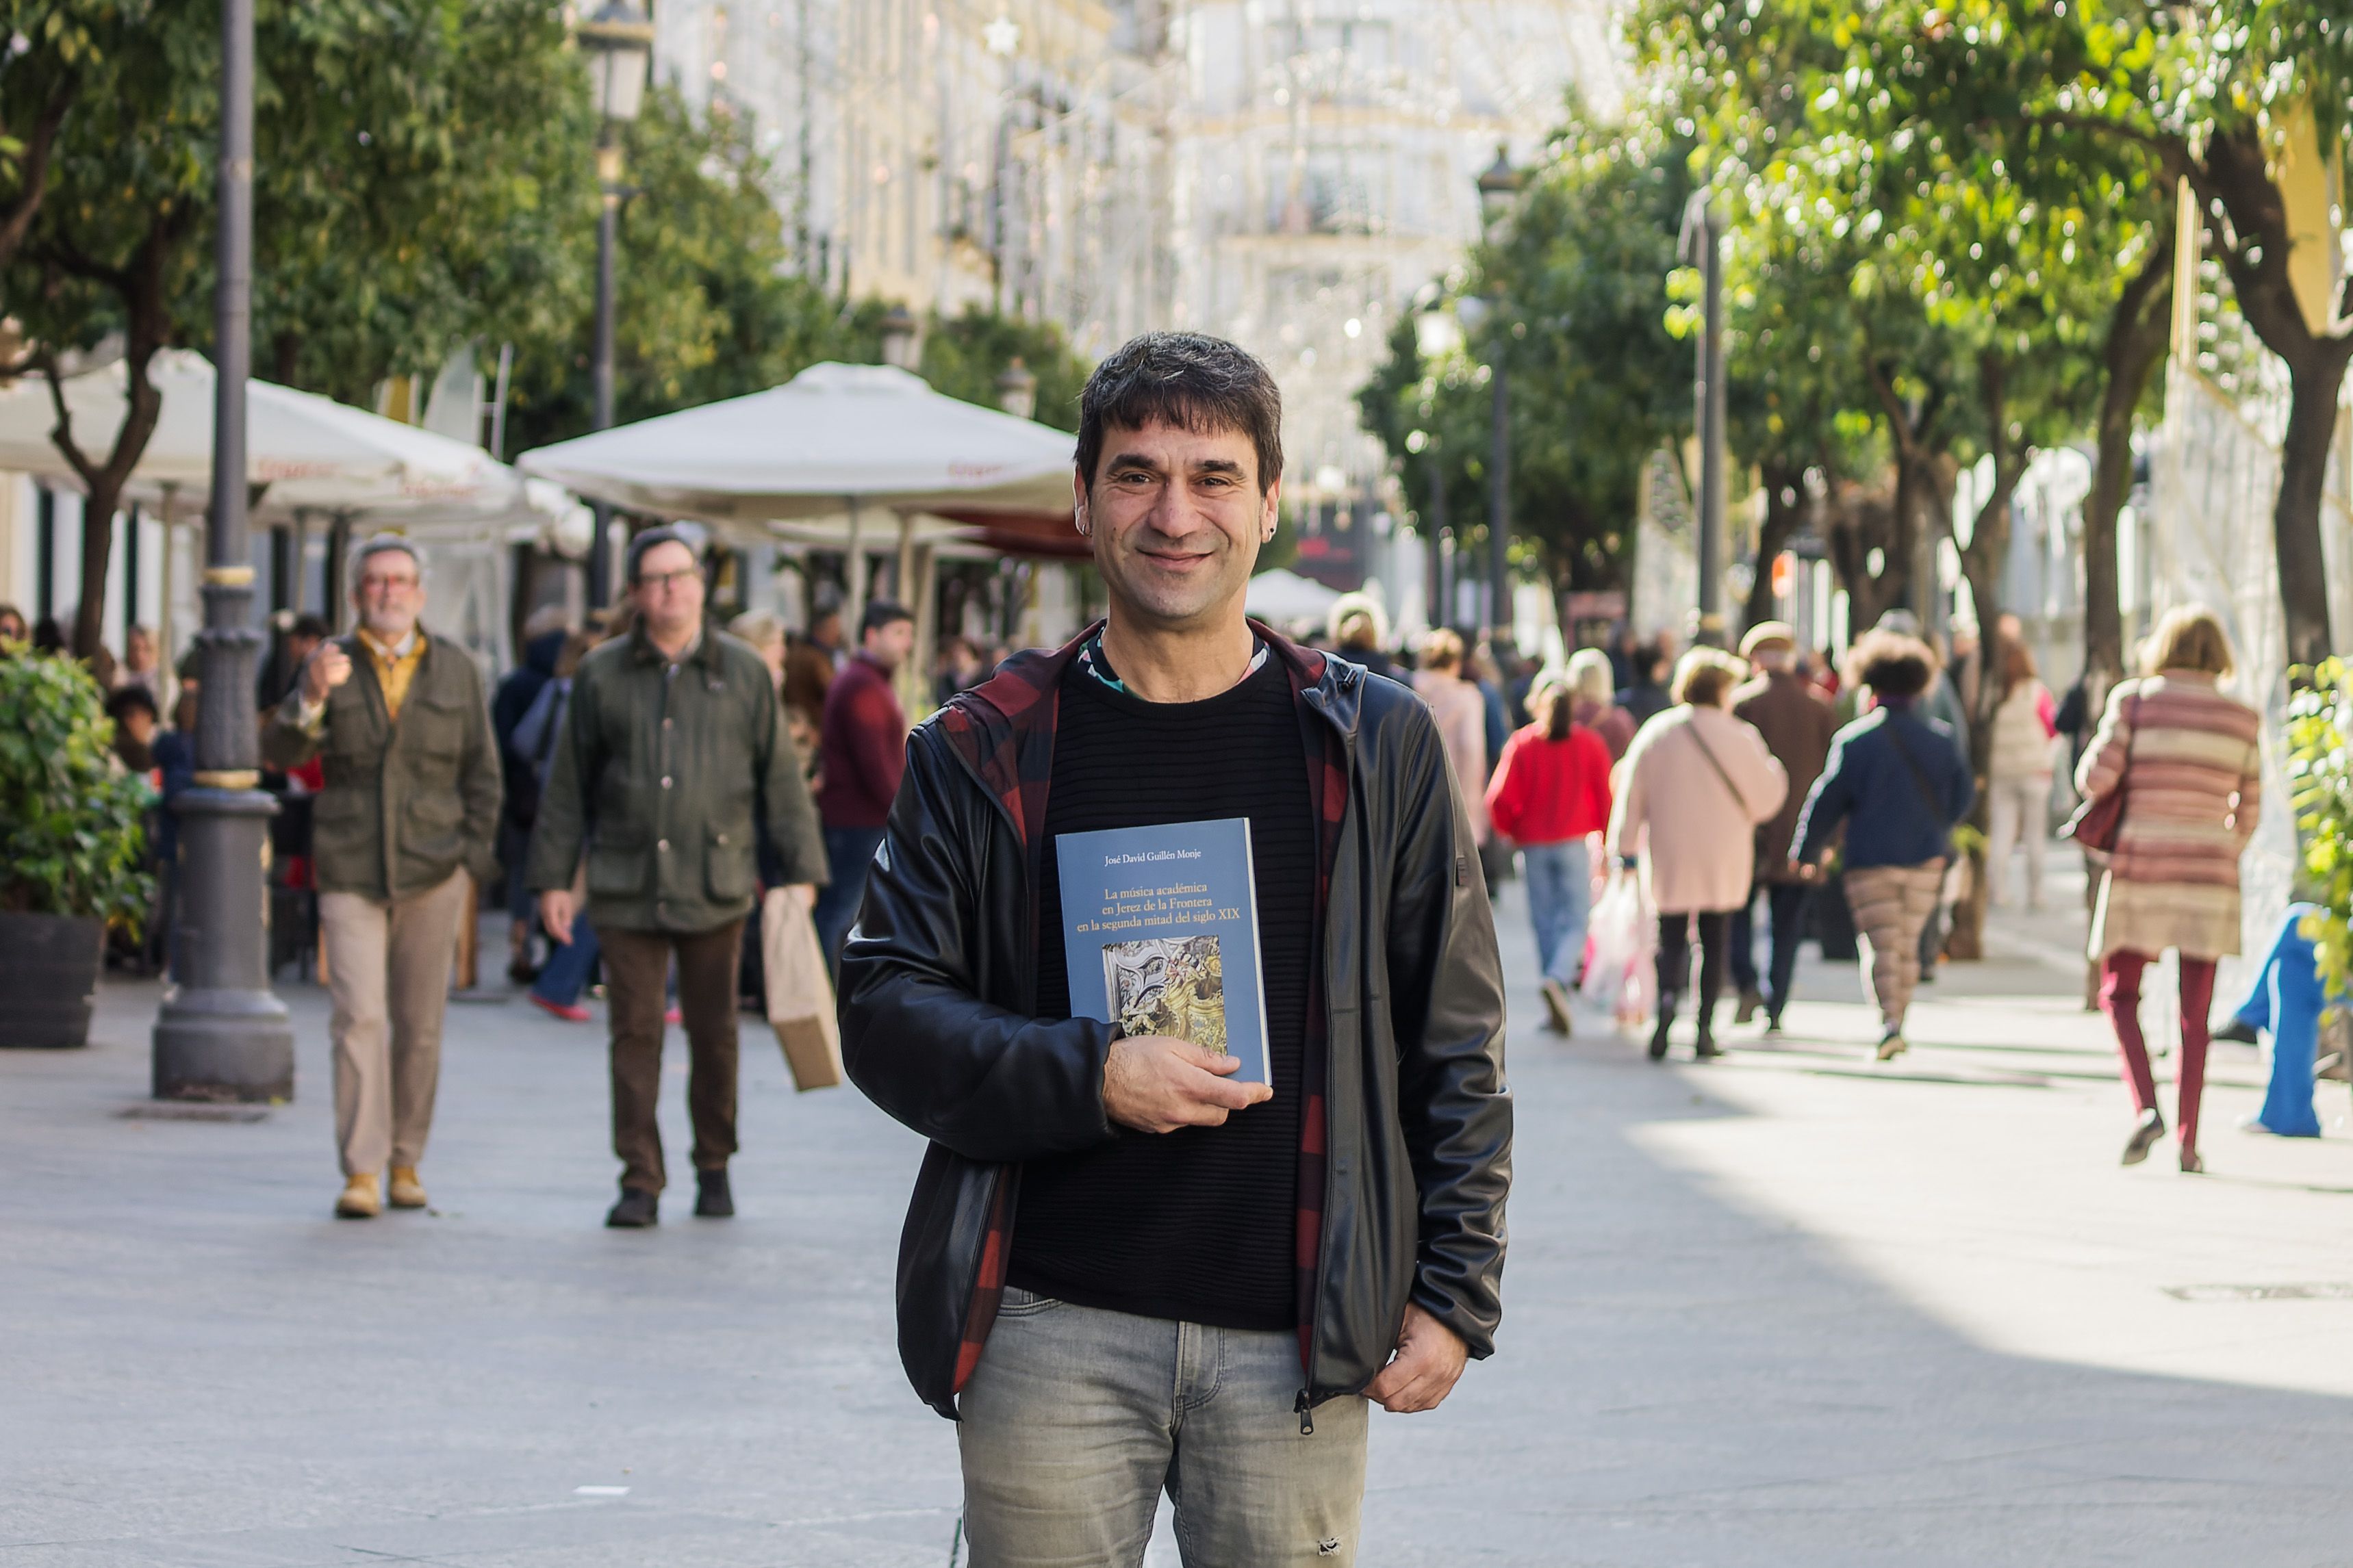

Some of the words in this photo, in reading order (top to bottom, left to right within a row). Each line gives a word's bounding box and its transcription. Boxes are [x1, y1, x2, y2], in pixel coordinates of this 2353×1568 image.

[1104, 855, 1121, 866] José
[1123, 853, 1145, 863] David
[1147, 851, 1175, 861] Guillén
[1177, 849, 1201, 859] Monje
[1105, 889, 1117, 900] La
[1120, 886, 1154, 898] música
[1156, 882, 1207, 896] académica
[1102, 906, 1114, 915] en
[1116, 903, 1140, 916] Jerez
[1144, 901, 1156, 911] de
[1158, 899, 1167, 910] la
[1169, 897, 1212, 909] Frontera
[1077, 924, 1089, 932] en
[1091, 920, 1099, 931] la
[1102, 916, 1141, 931] segunda
[1145, 913, 1172, 925] mitad
[1175, 912, 1190, 923] del
[1193, 911, 1215, 923] siglo
[1219, 908, 1240, 920] XIX
